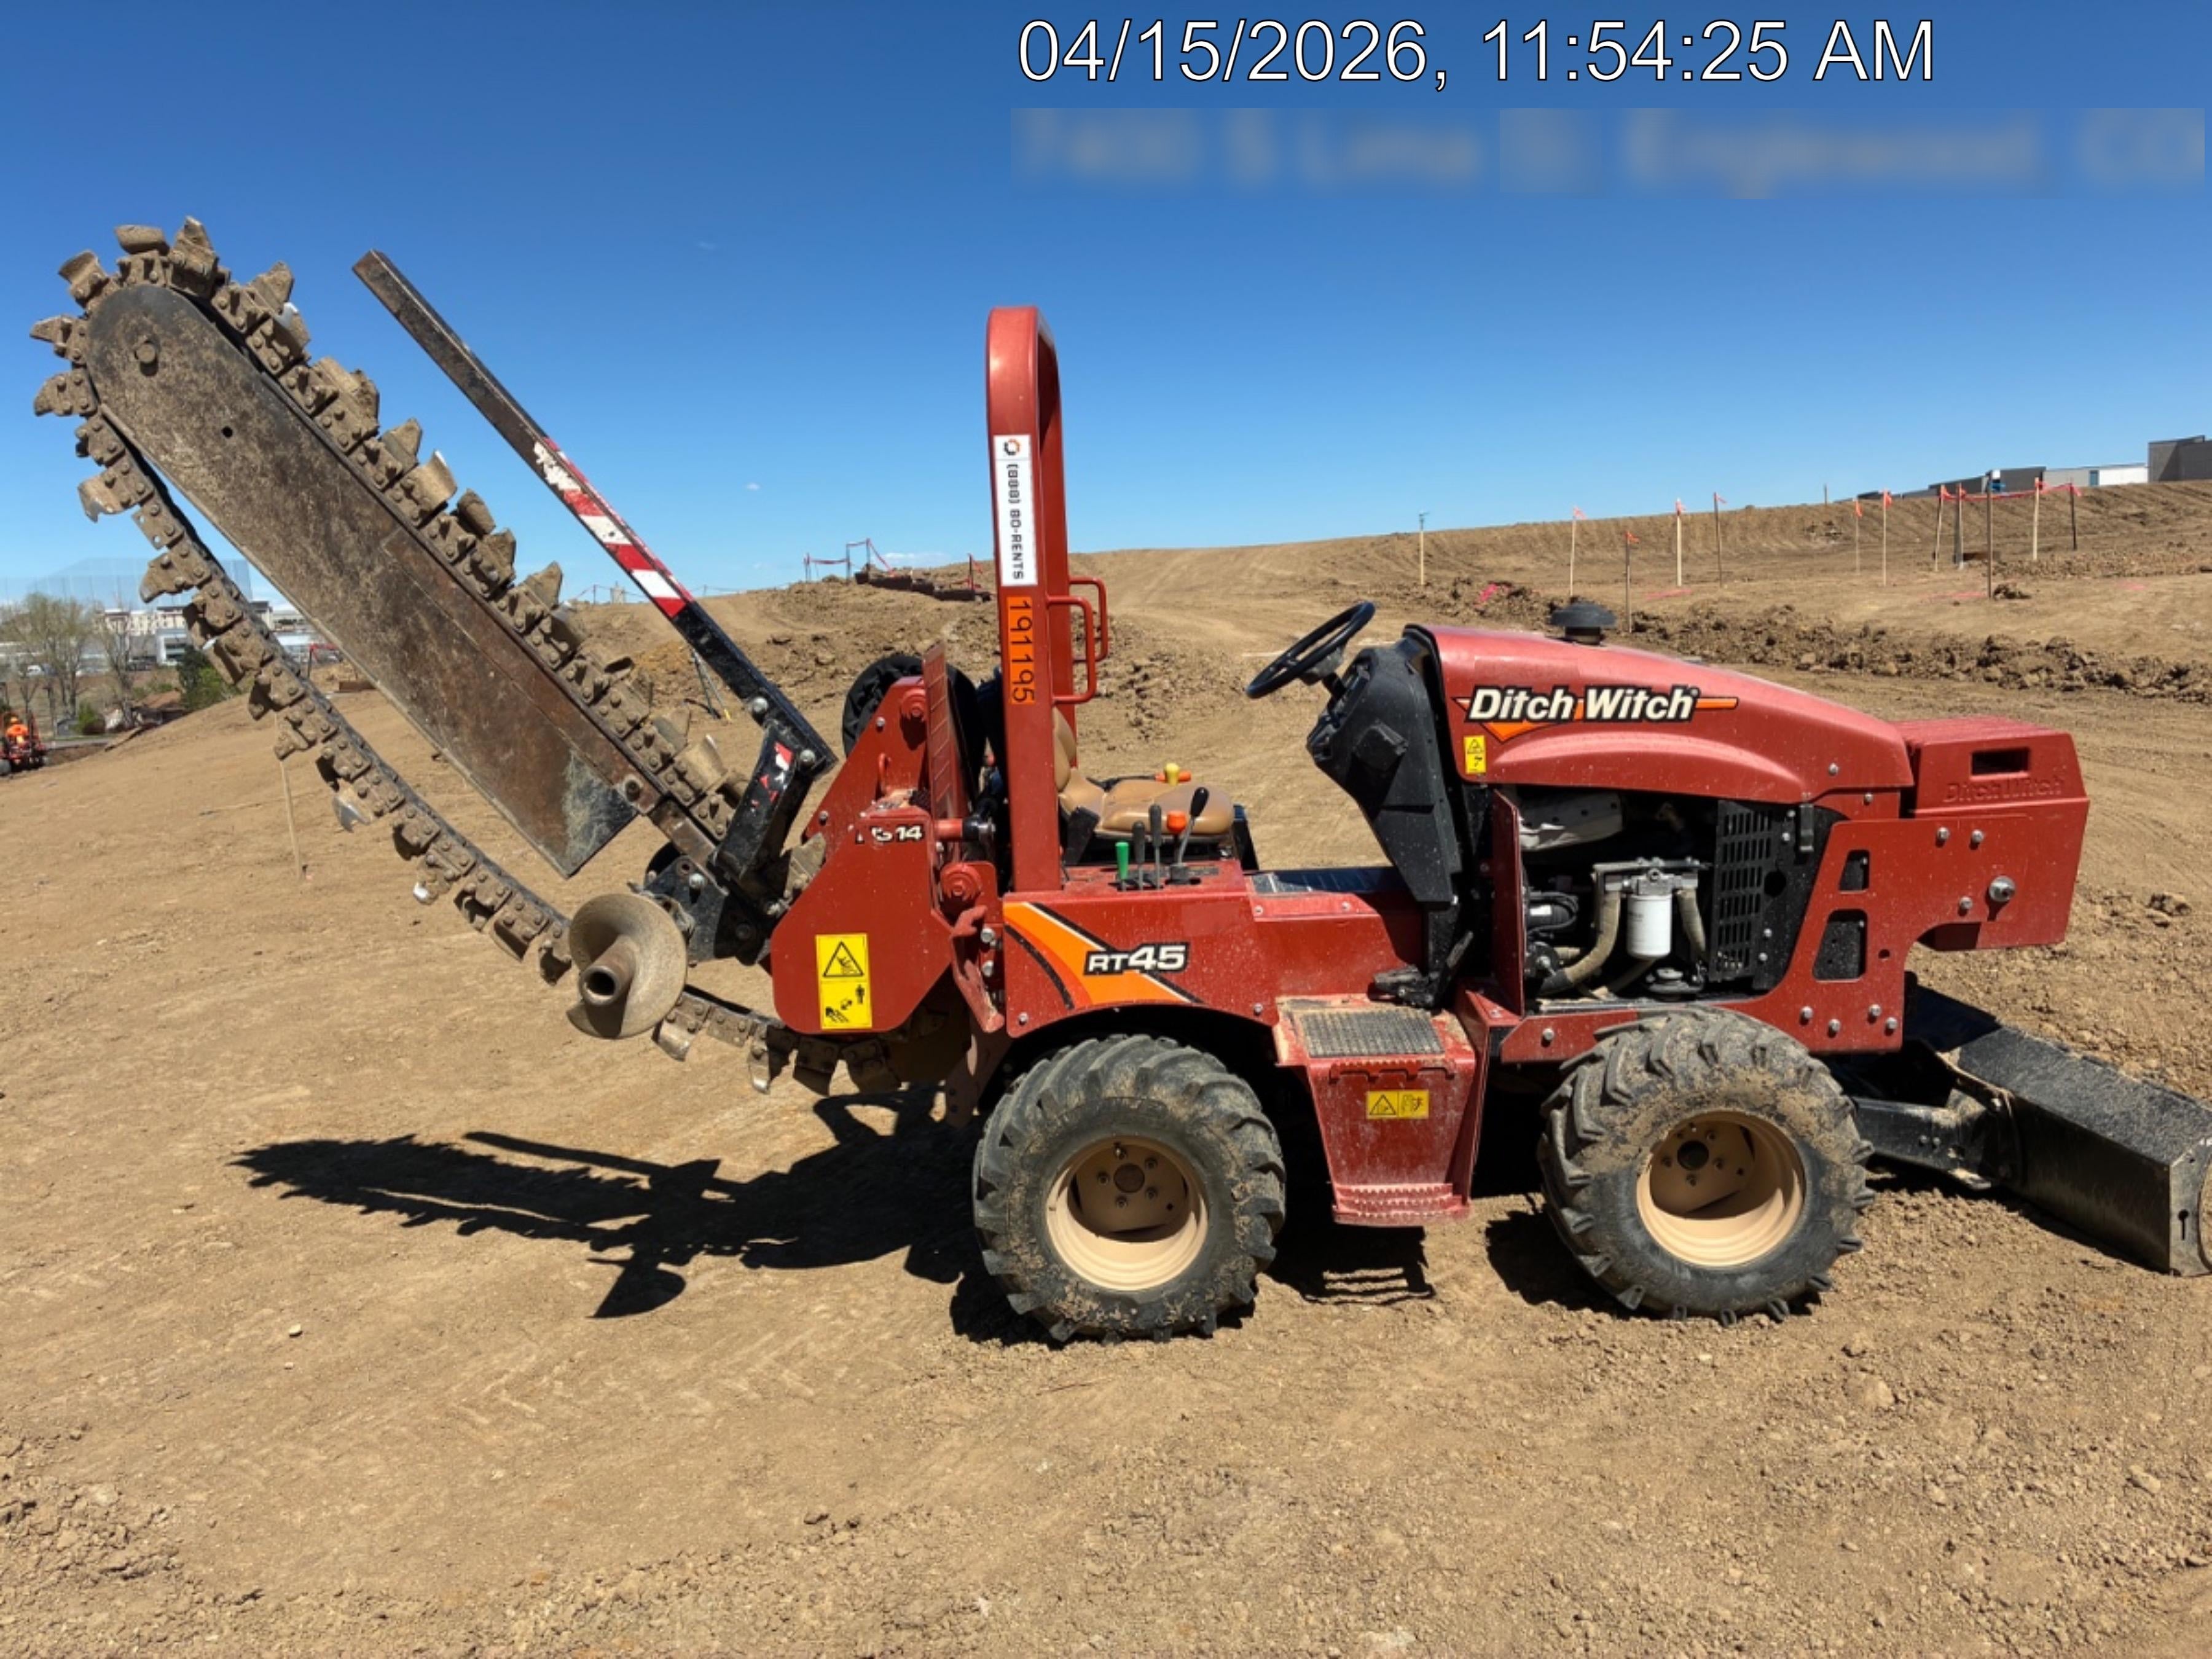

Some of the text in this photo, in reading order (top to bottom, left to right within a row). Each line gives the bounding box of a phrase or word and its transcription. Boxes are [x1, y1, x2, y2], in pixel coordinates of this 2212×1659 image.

[1010, 509, 1024, 579] 80-RENTS
[1010, 600, 1035, 703] 191195
[1469, 686, 1695, 721] Ditch Witch
[1088, 944, 1186, 973] RT45
